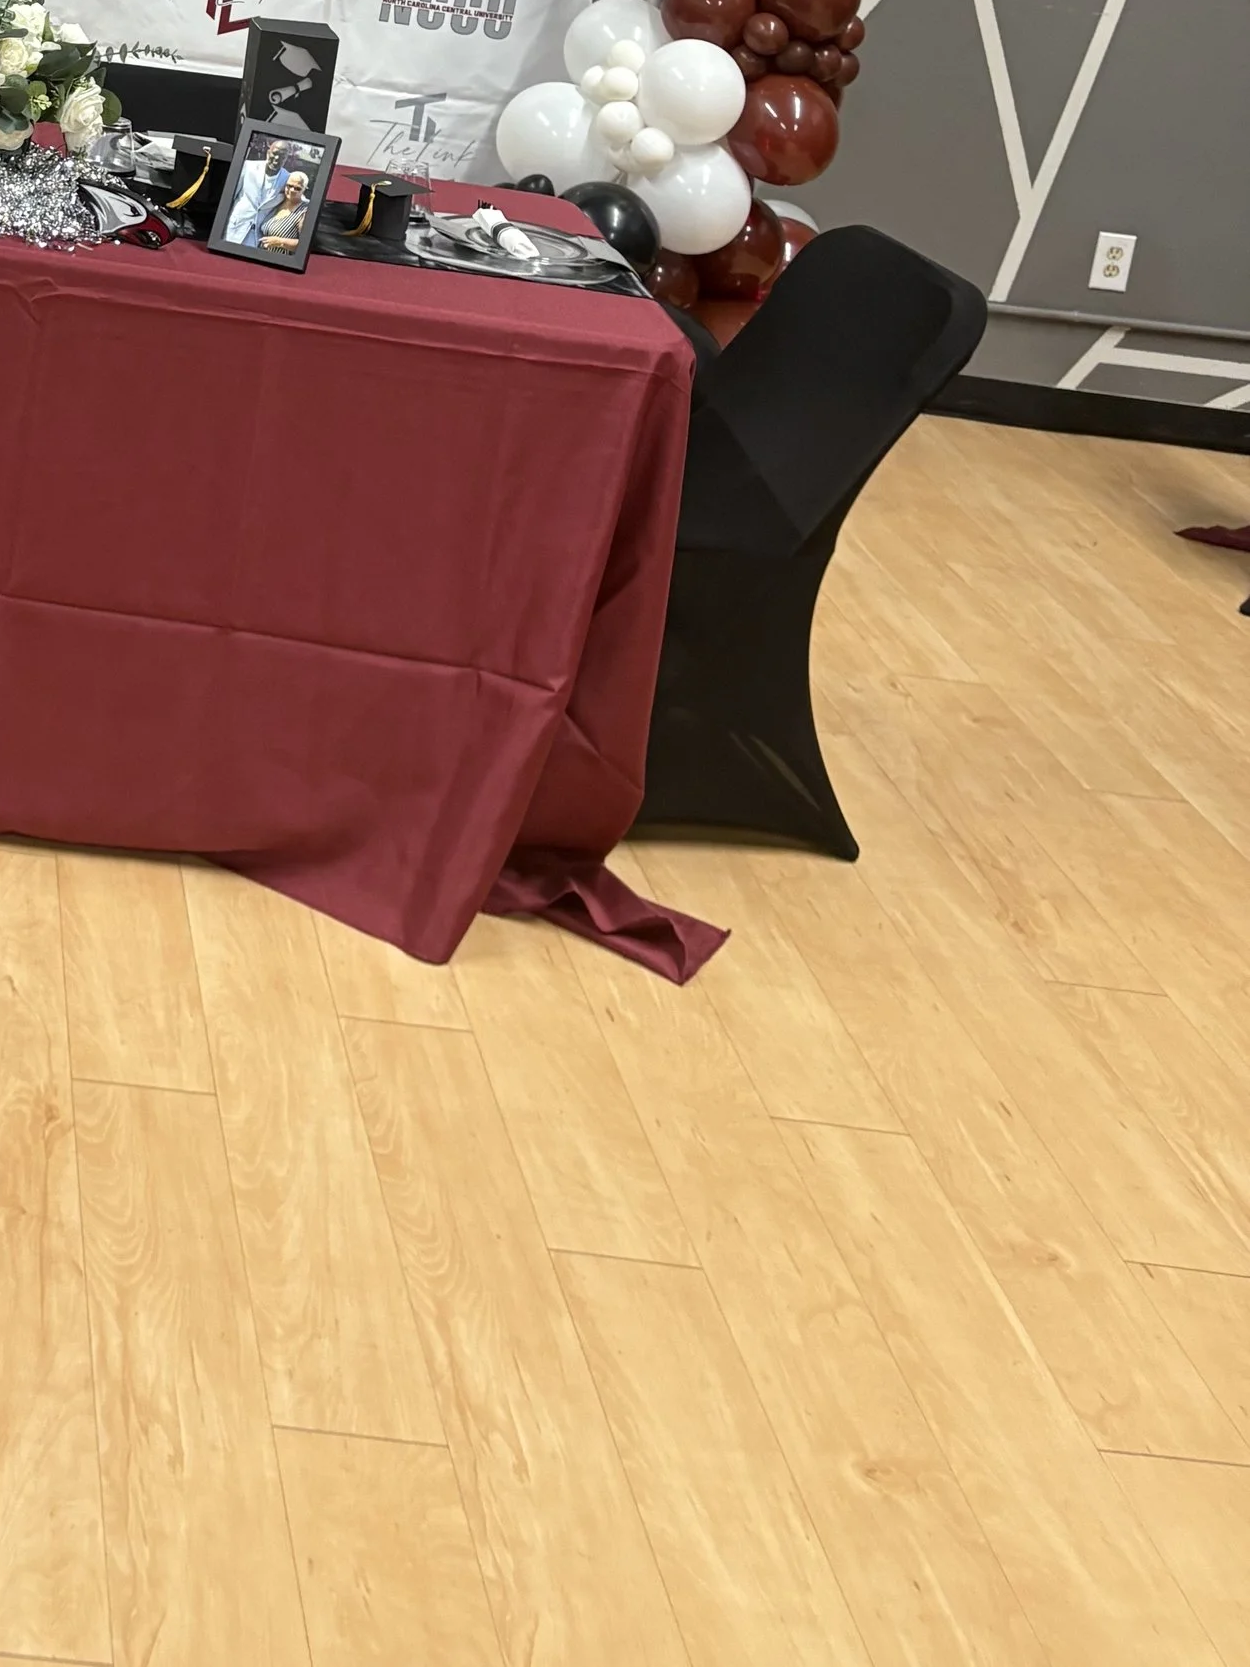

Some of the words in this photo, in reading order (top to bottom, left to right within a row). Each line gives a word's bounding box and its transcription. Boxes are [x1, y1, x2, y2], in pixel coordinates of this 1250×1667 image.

[407, 0, 440, 11] CAROLINA
[442, 5, 473, 16] CENTRAL
[474, 10, 513, 21] UNIVERSITY
